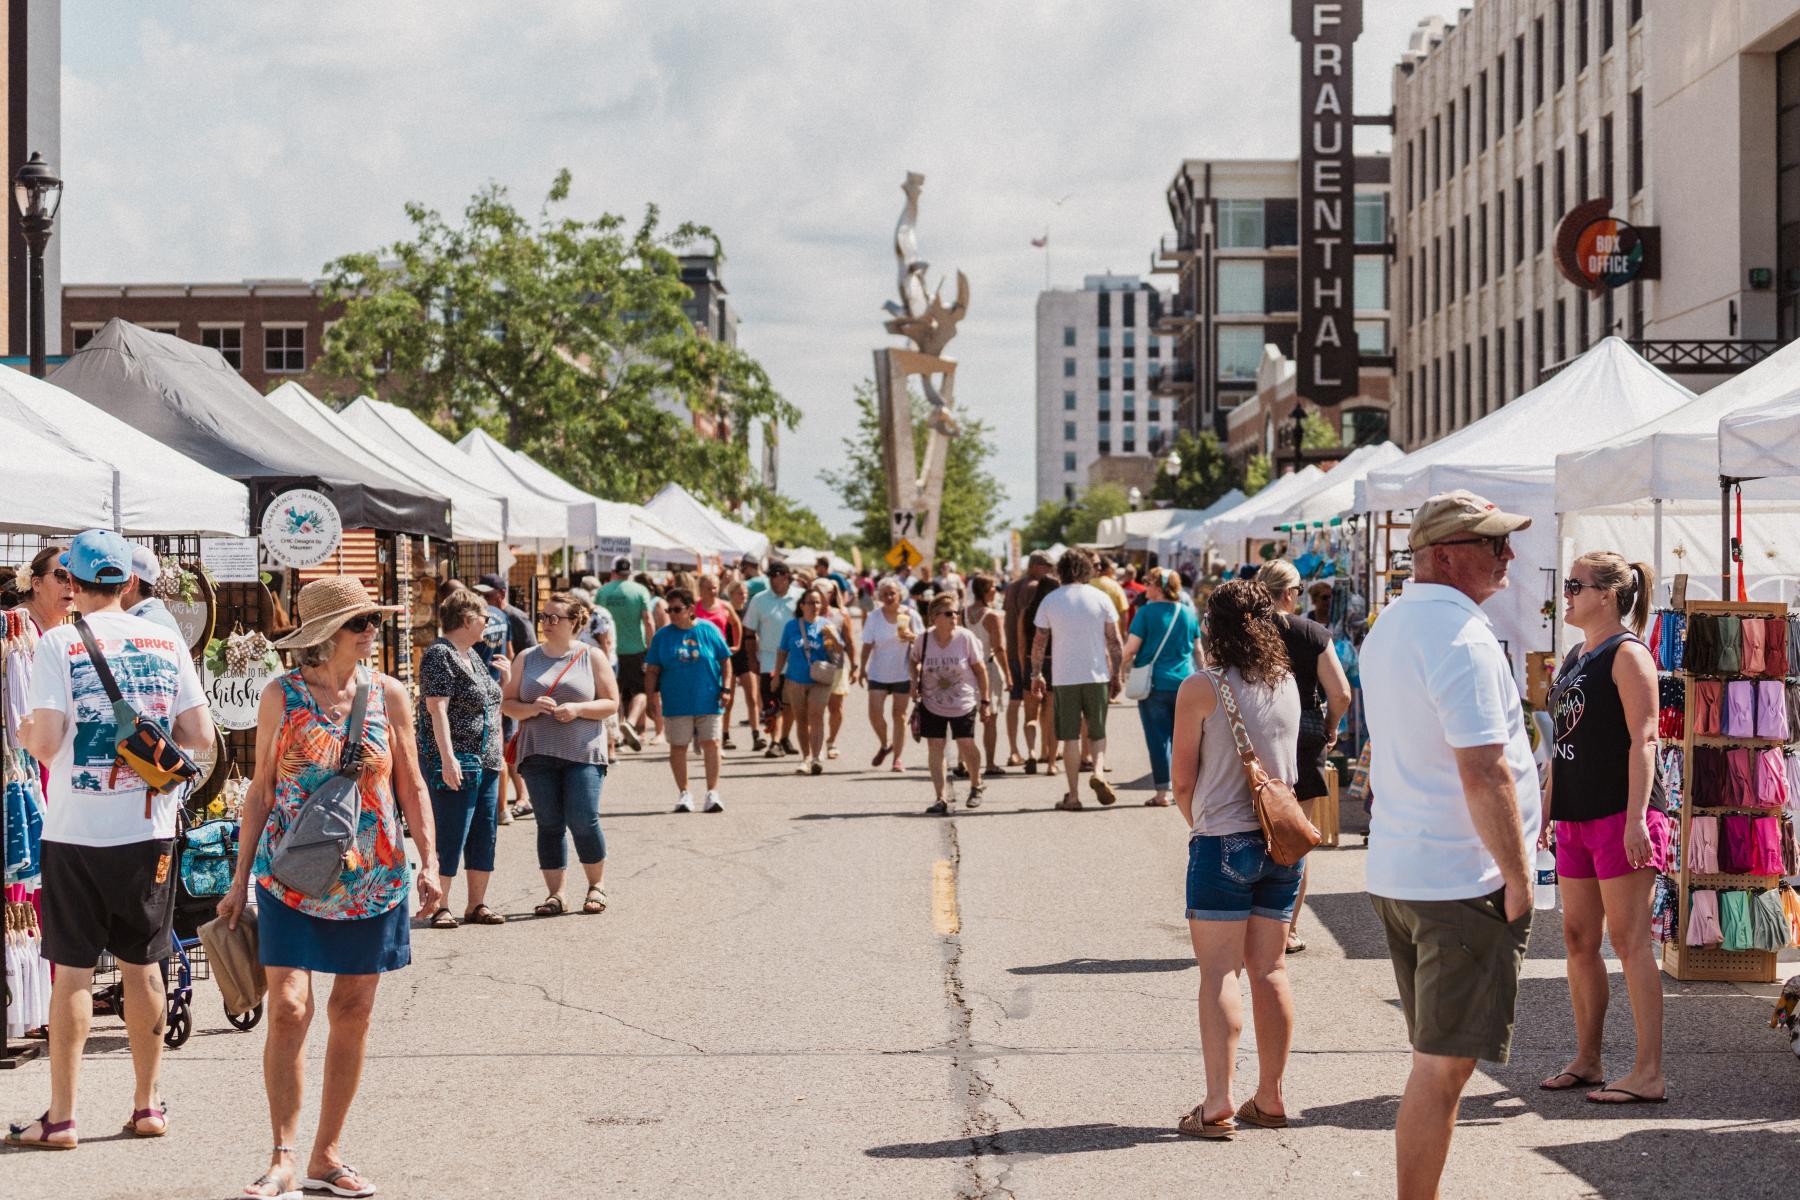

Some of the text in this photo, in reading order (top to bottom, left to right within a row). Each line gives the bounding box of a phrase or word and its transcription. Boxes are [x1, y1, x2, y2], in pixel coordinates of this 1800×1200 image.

[1313, 4, 1342, 385] FRAUENTHAL
[1596, 235, 1620, 253] BOX
[1589, 255, 1628, 273] OFFICE
[266, 495, 293, 529] CHARMING
[302, 493, 337, 523] HANDMADE
[268, 540, 292, 563] CRAFTY
[300, 530, 338, 566] IMAGINATIVE
[68, 639, 105, 656] JAS
[1553, 674, 1588, 687] LVE
